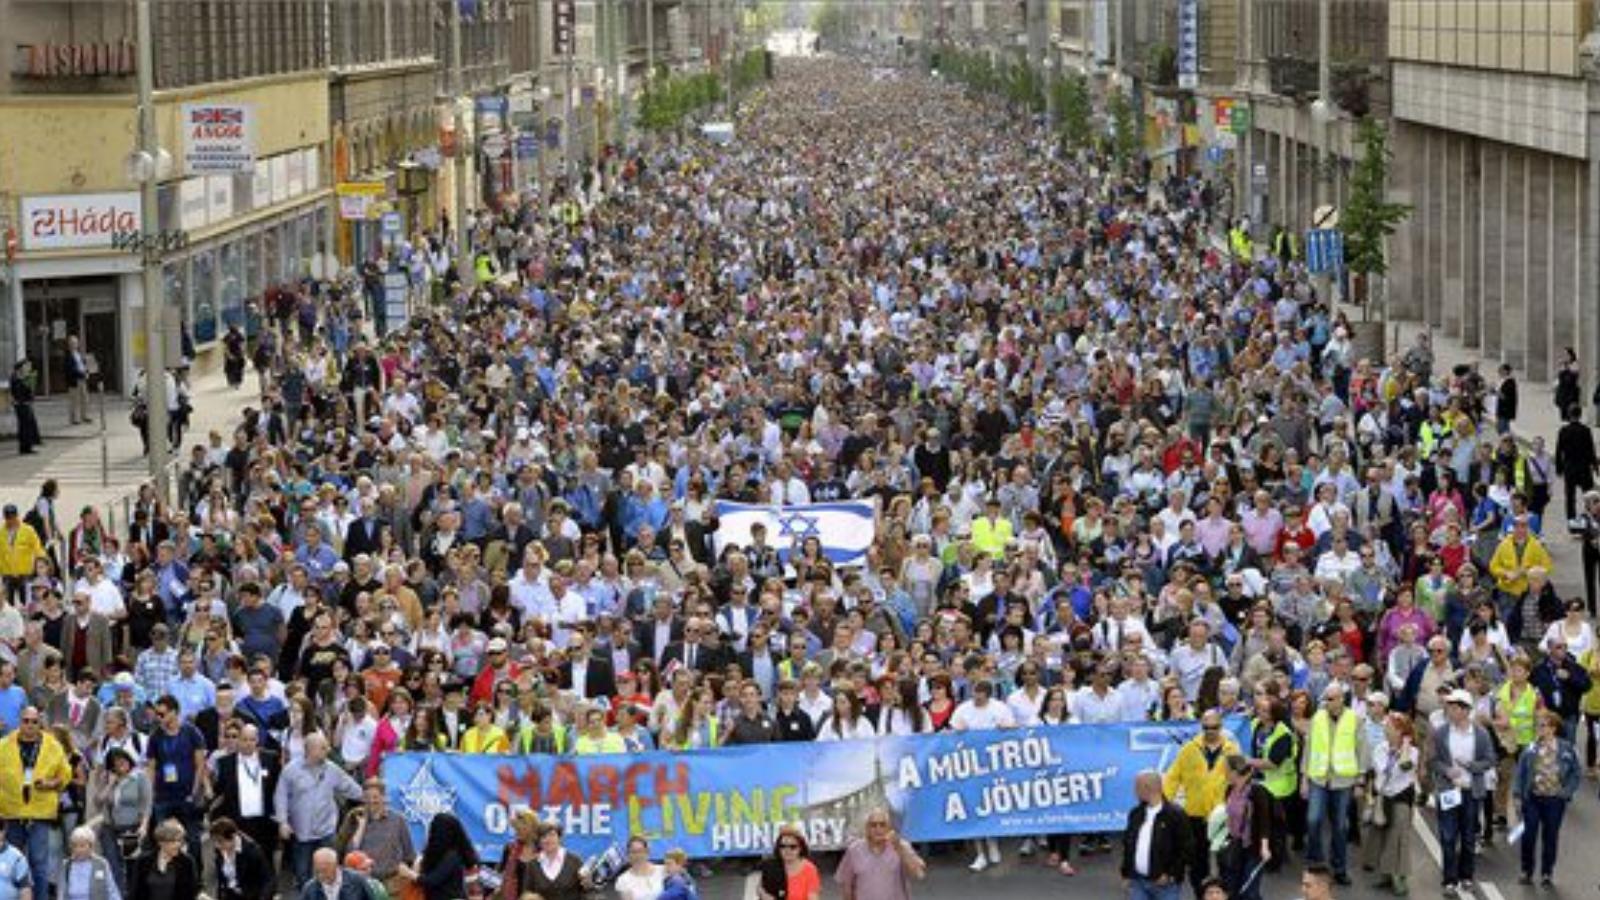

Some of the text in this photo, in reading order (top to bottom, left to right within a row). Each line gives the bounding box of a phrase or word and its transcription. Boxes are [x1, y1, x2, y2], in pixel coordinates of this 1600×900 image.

[59, 206, 137, 236] Háda
[899, 729, 1062, 789] A MÚLTRÓL
[496, 760, 690, 813] MARCH
[542, 803, 612, 835] THE
[628, 784, 799, 840] LIVING
[945, 792, 968, 822] A
